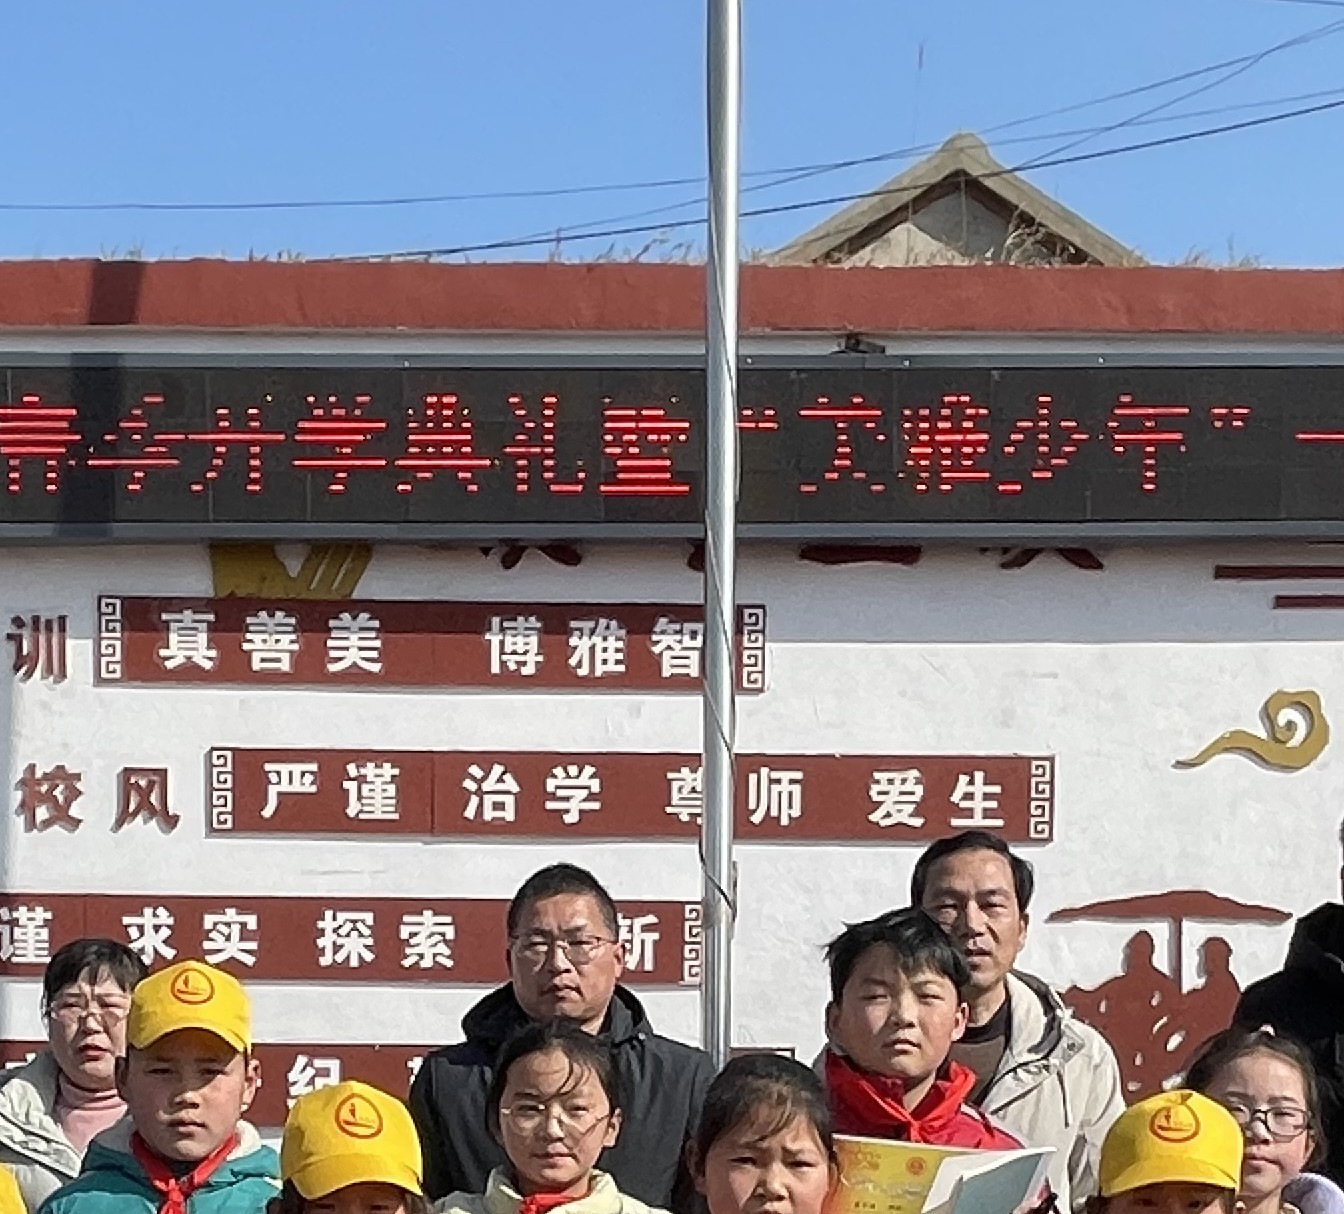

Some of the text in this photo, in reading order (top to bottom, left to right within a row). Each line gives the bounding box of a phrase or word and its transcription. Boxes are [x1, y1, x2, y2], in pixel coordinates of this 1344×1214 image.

[158, 608, 384, 671] 真善美
[484, 614, 704, 678] 博雅智
[15, 761, 1005, 834] 校风 严谨 治学 尊师 爱生
[122, 907, 259, 968] 求实
[315, 908, 456, 970] 探索
[287, 1054, 342, 1108] 纪
